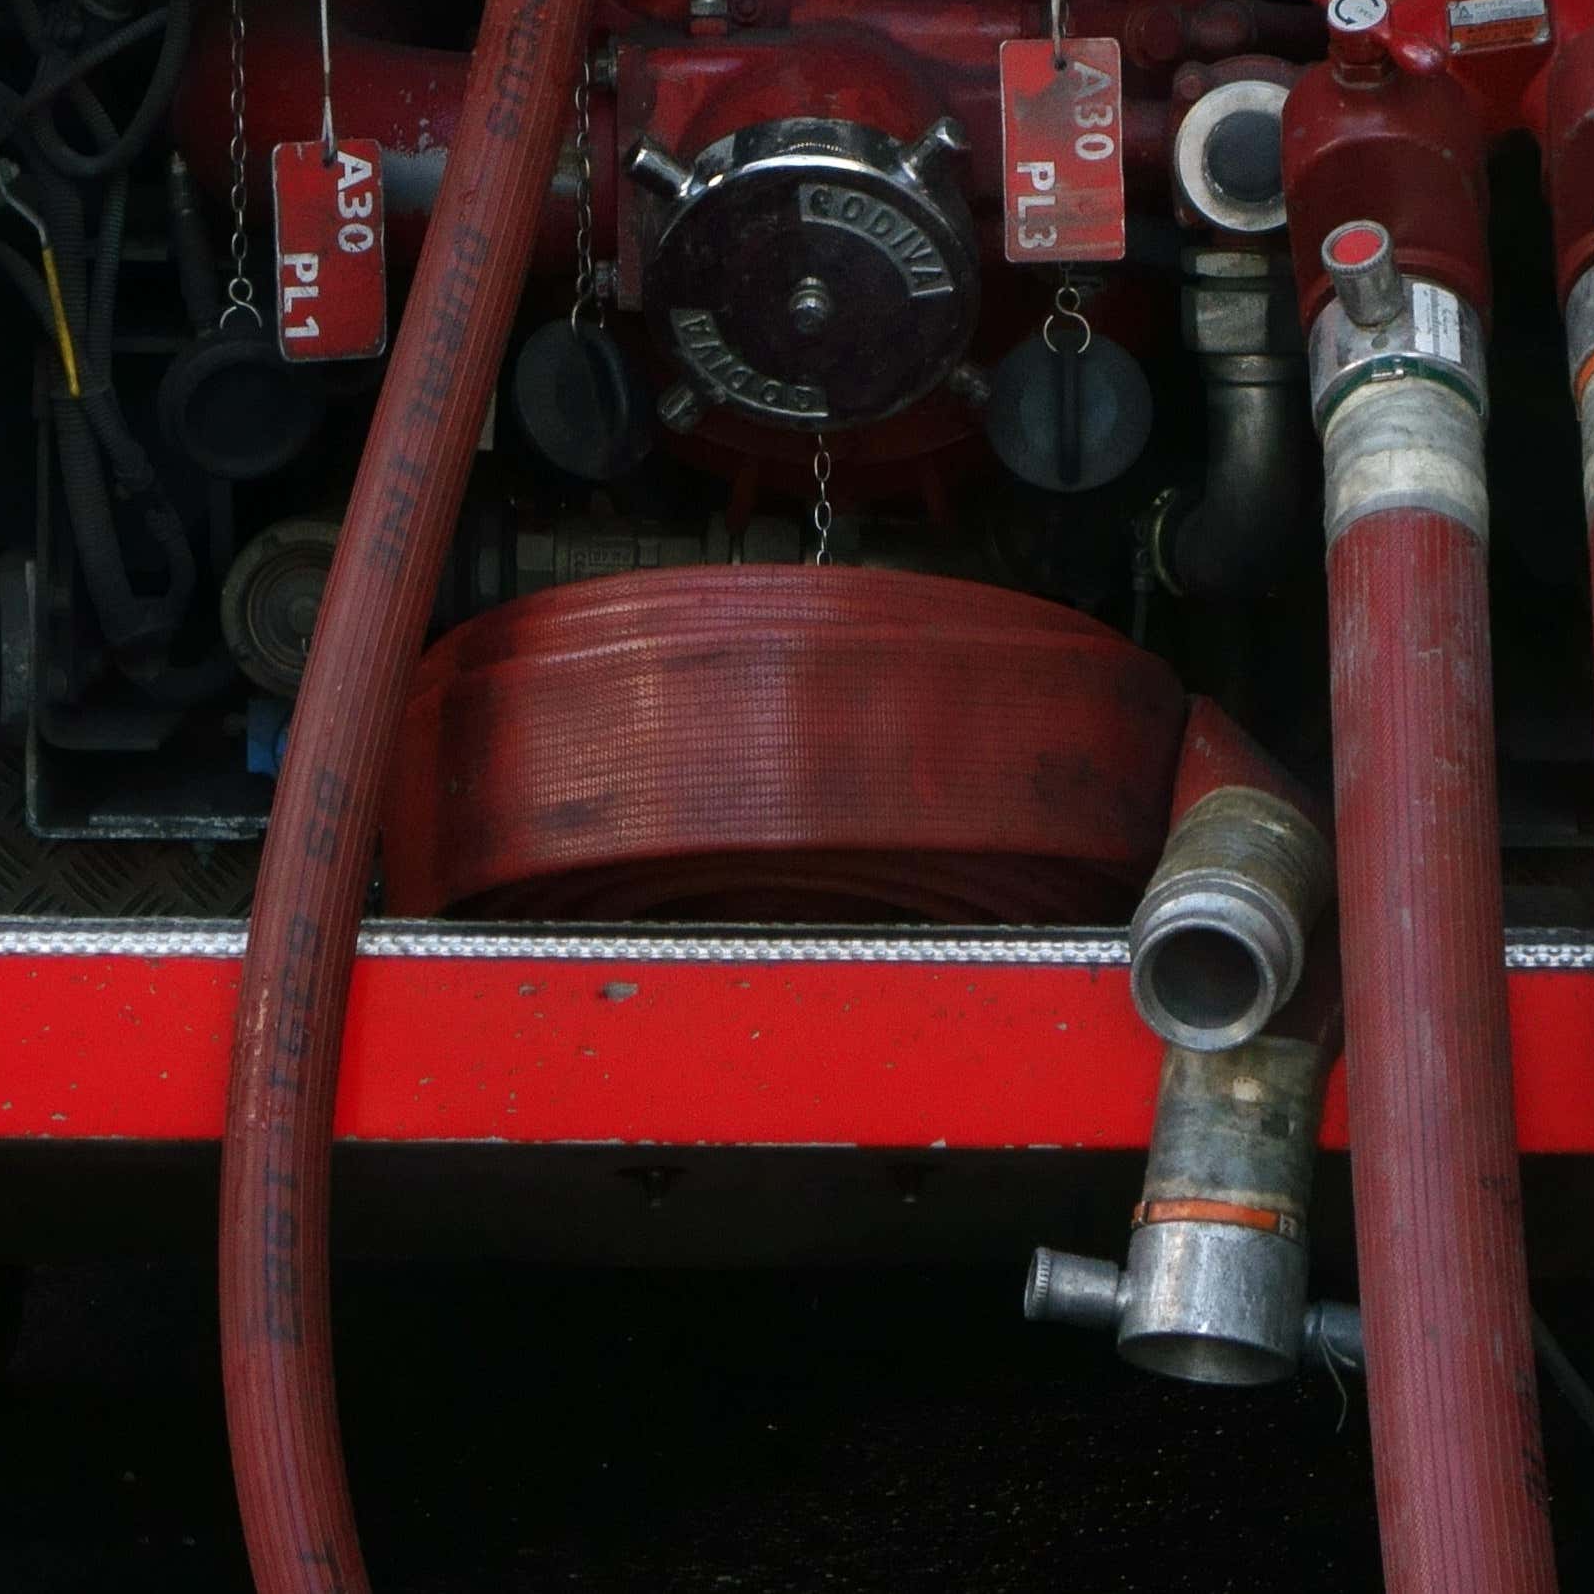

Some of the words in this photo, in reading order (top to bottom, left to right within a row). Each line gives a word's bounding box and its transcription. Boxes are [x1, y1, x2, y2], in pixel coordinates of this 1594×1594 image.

[1072, 60, 1115, 162] A30
[336, 150, 374, 253] A30
[1016, 160, 1058, 250] PL3
